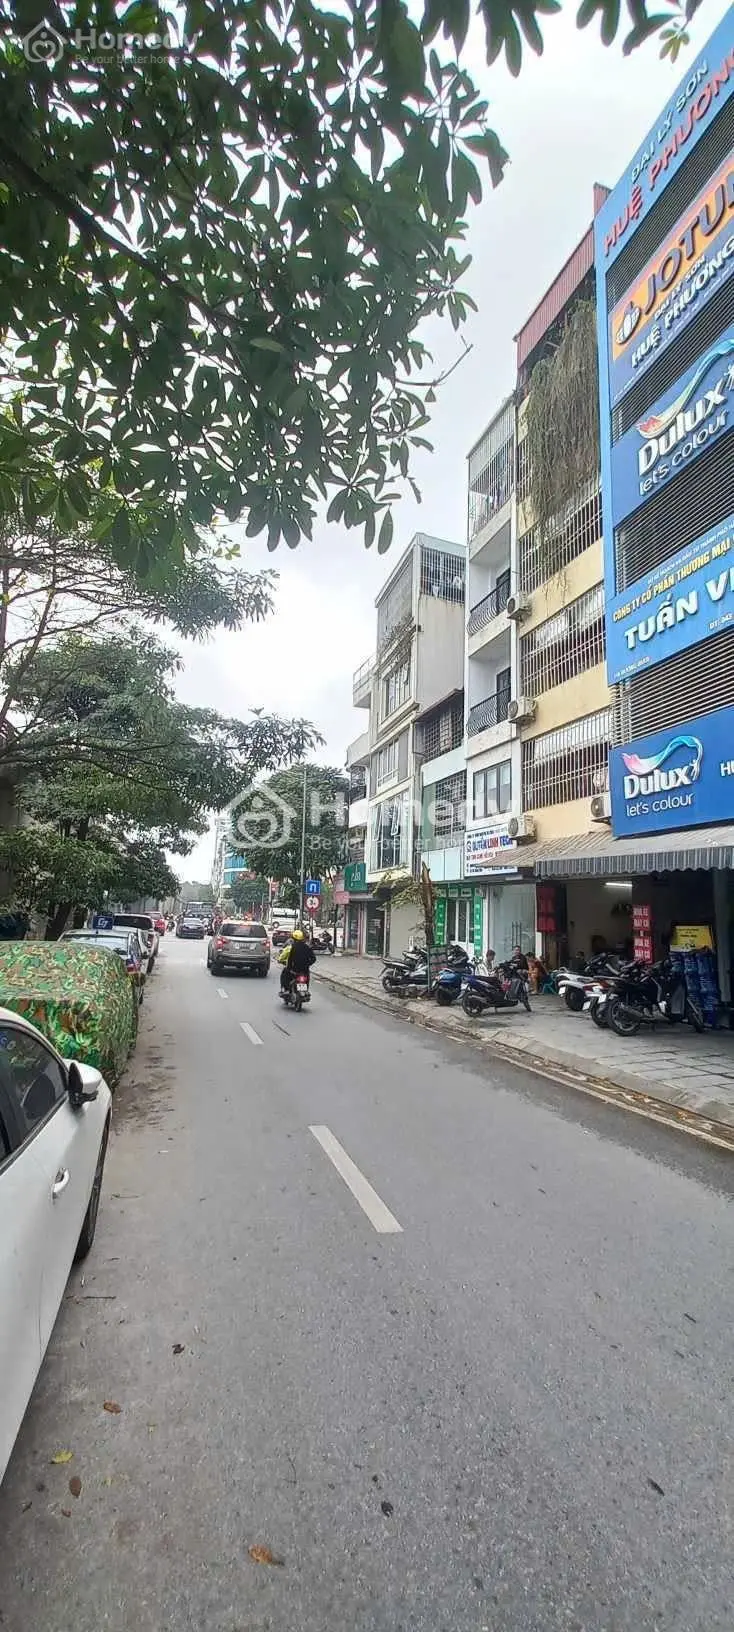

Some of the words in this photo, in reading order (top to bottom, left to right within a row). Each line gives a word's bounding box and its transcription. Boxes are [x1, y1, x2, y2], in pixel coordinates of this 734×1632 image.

[603, 183, 643, 258] HUỆ
[649, 47, 734, 192] PHƯƠN
[631, 324, 661, 369] HUỆ
[638, 377, 727, 476] Dulux
[672, 411, 727, 466] colour
[624, 591, 699, 649] TUẤN
[624, 765, 692, 800] Dulux
[626, 801, 649, 817] let's
[652, 792, 696, 812] colour
